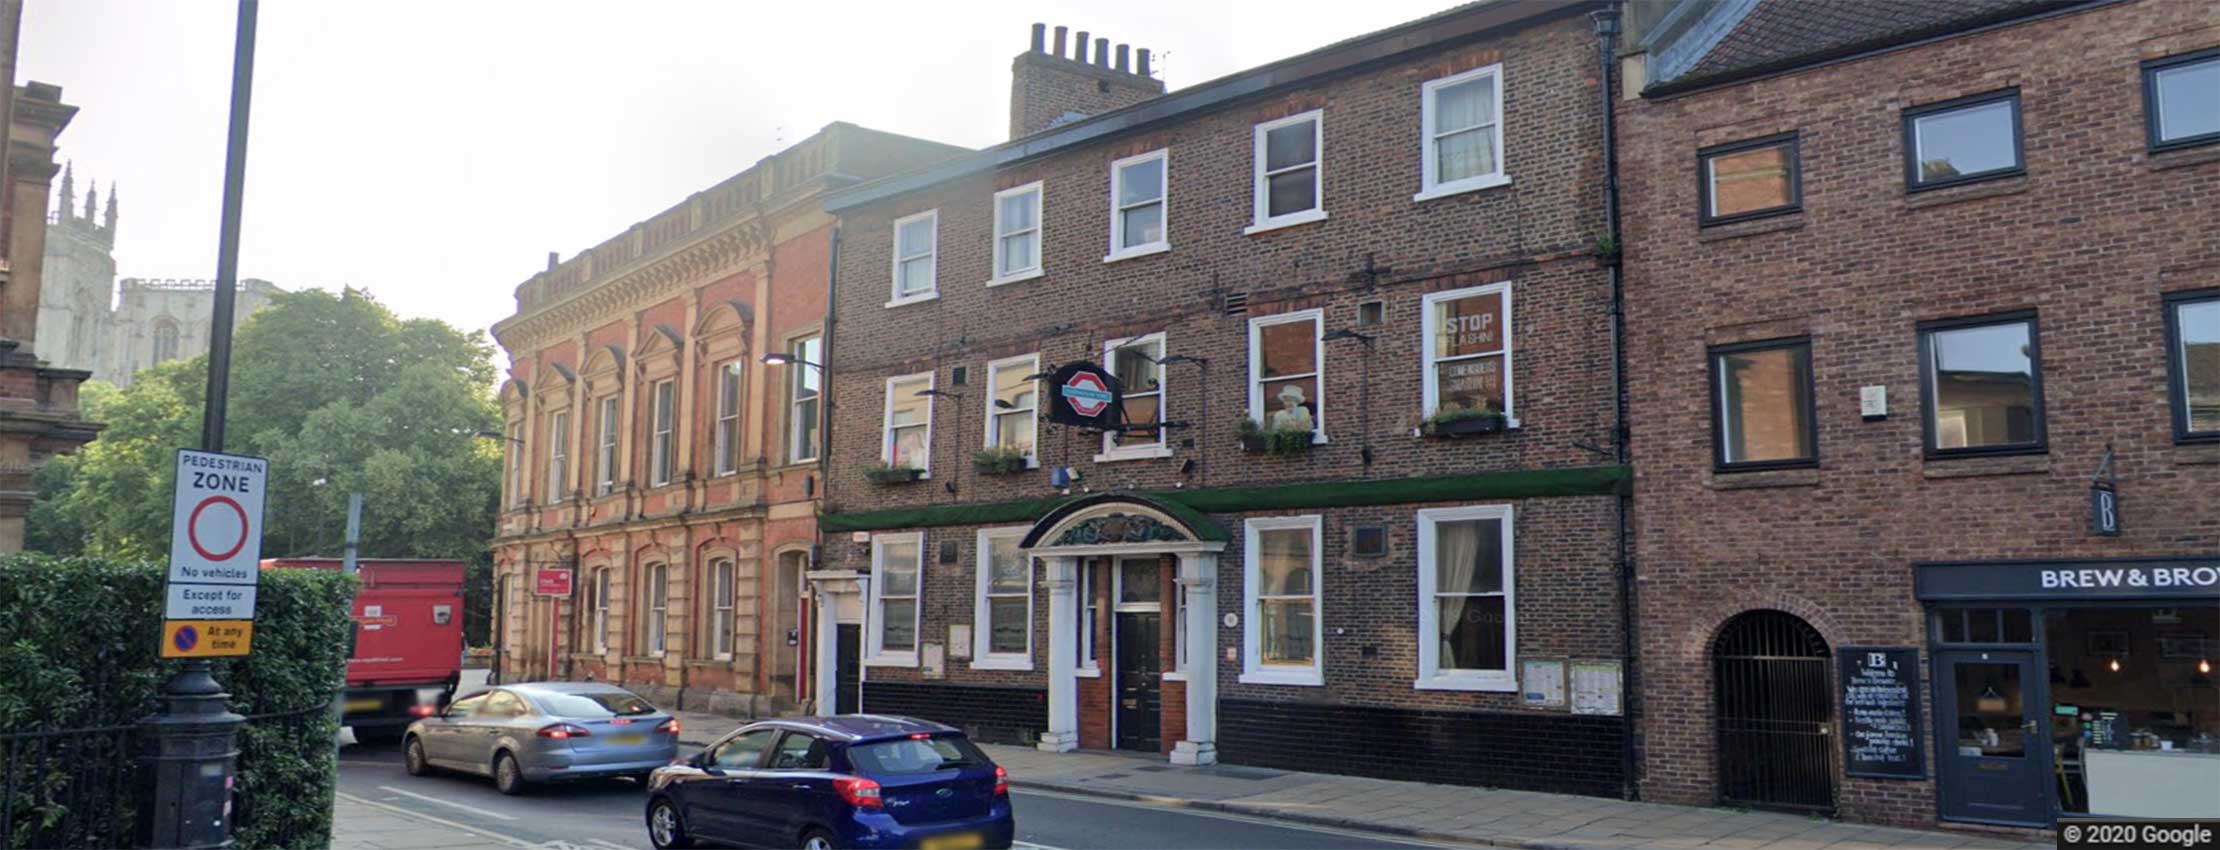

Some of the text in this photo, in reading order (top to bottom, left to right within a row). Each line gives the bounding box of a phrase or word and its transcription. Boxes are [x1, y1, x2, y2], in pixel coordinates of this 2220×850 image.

[1446, 313, 1492, 334] STOP
[182, 455, 263, 473] PEDESTRIAN
[193, 472, 250, 493] ZONE
[2100, 490, 2116, 531] B
[181, 566, 248, 579] No vehicles
[2041, 567, 2220, 588] BREW & BRO
[183, 589, 243, 602] Except for
[191, 606, 232, 615] access
[207, 626, 243, 638] At any
[211, 641, 237, 650] time
